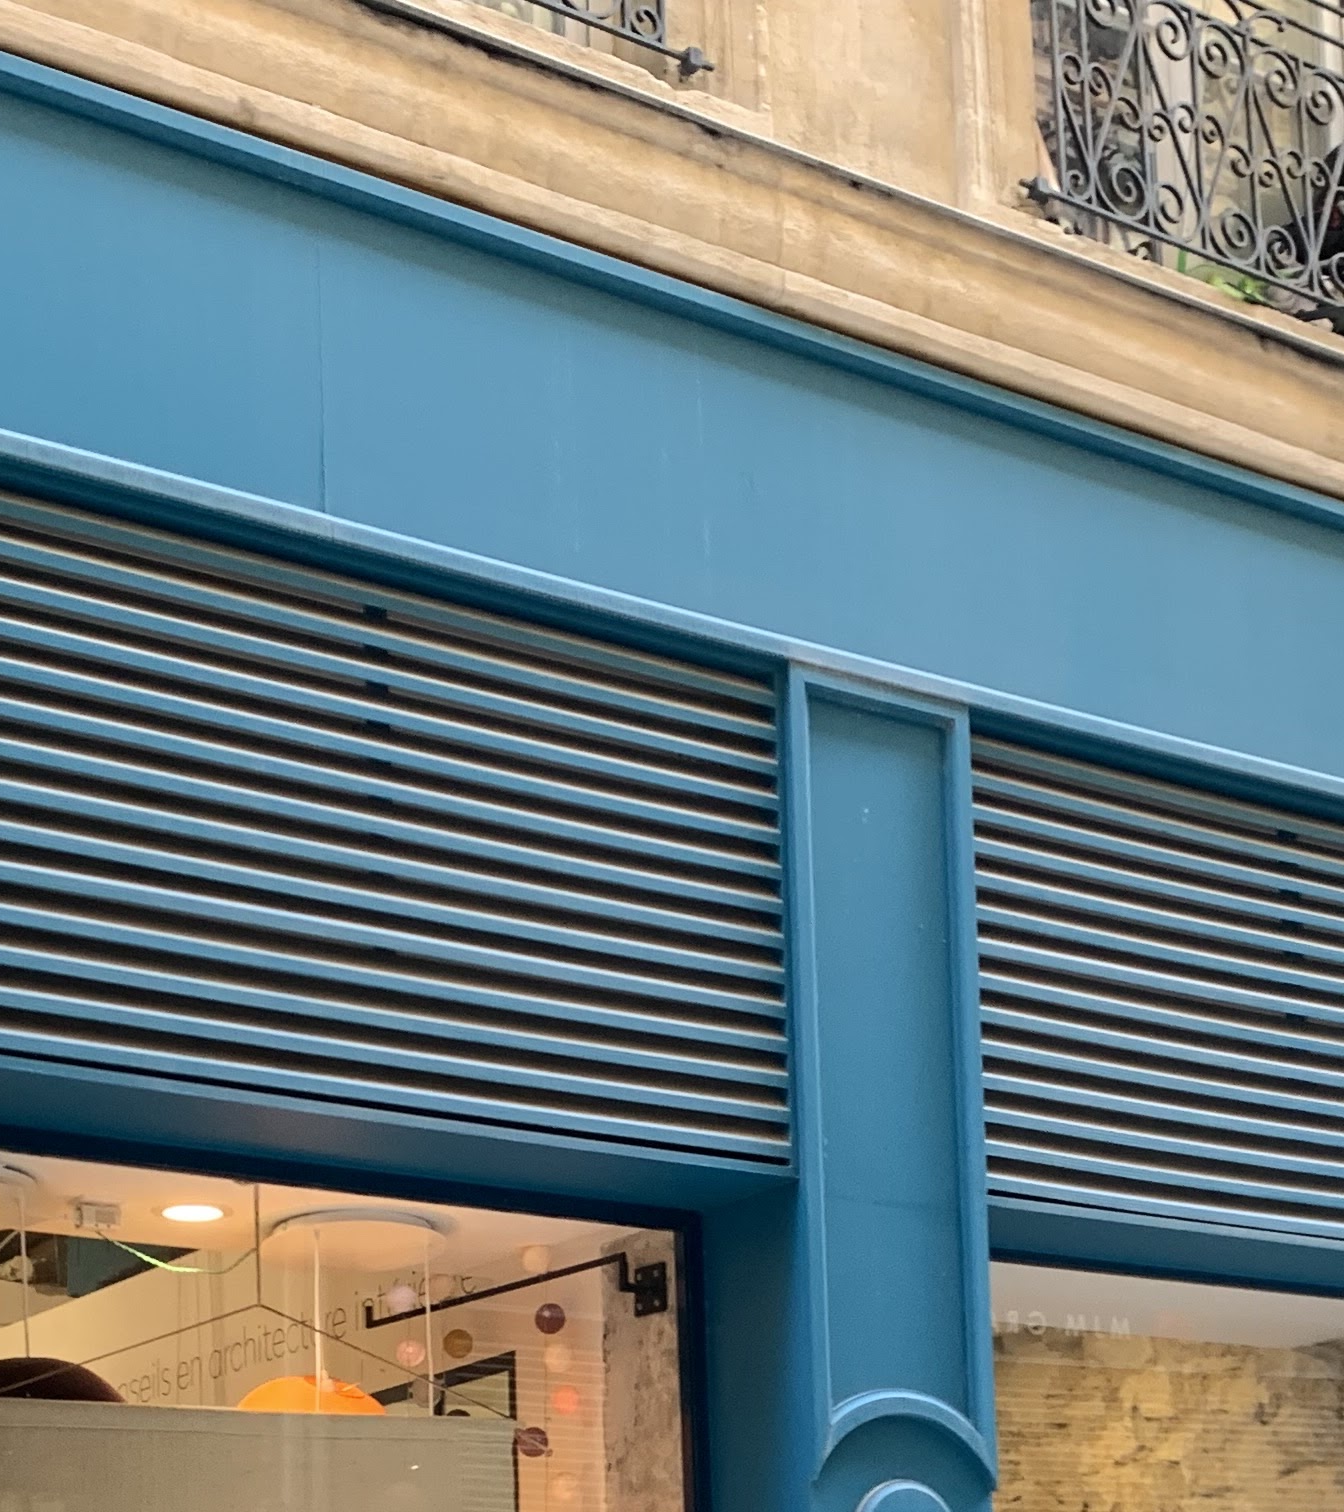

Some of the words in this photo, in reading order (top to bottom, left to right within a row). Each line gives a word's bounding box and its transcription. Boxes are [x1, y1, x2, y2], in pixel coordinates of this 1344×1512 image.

[117, 1354, 172, 1404] nseils
[175, 1355, 203, 1391] en
[208, 1305, 347, 1380] architecture
